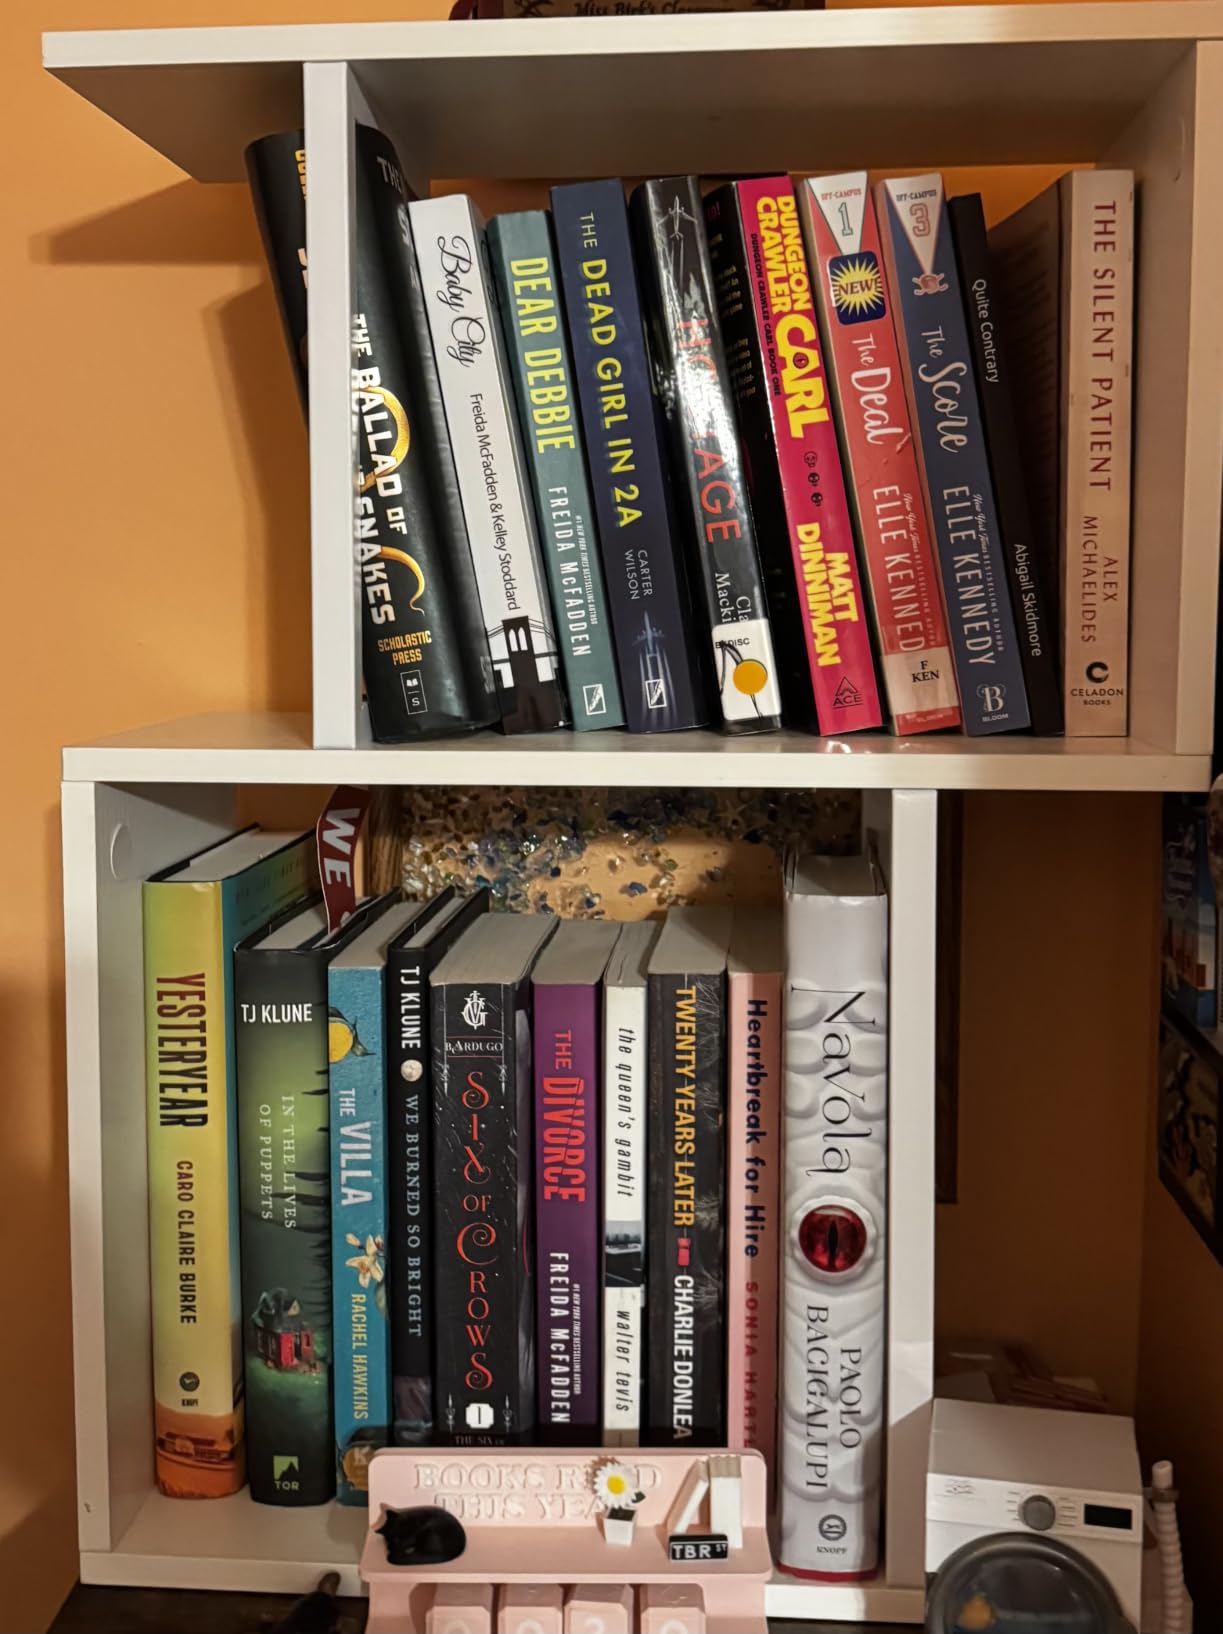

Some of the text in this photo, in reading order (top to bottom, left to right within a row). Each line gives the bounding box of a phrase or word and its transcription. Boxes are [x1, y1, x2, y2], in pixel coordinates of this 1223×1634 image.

[756, 196, 792, 315] CRAWLER
[776, 195, 812, 312] DUNGEON
[837, 202, 853, 236] 1
[909, 203, 931, 237] 3
[437, 235, 486, 368] Baby City
[510, 256, 576, 454] DEAR DEBBIE
[751, 233, 781, 396] DUNGEON CRAWLER CARL BOOK ONE
[972, 279, 999, 383] Quite Contrary
[1089, 200, 1116, 491] THE SILENT PATIENT
[579, 211, 643, 527] THE DEAD GIRL IN 2A
[775, 314, 830, 438] CARL
[851, 332, 903, 446] The Deal
[918, 325, 968, 453] The Score
[357, 366, 404, 497] BALLAD
[386, 506, 408, 535] OF
[676, 319, 742, 543] HOAGE
[470, 392, 521, 611] Freida McFadden & Kelley Stoddard
[548, 486, 576, 552] FREIDA
[624, 549, 640, 600] WILSON
[637, 549, 653, 596] CARTER
[796, 522, 842, 667] DINNIMAN
[825, 552, 859, 622] MATT
[873, 485, 925, 651] ELLE KENNED
[943, 485, 996, 665] ELLE KENNEDY
[1014, 543, 1042, 657] Abigail Skidmore
[1081, 515, 1098, 643] MICHAELIDES
[1103, 556, 1119, 602] ALEX
[377, 630, 432, 652] SCHOLASTIC
[392, 647, 422, 665] PRESS
[911, 670, 939, 683] KEN
[920, 660, 928, 670] F
[1070, 688, 1124, 697] CELADON
[833, 693, 862, 707] ACE
[155, 972, 208, 1127] YESTERYEAR
[241, 1003, 313, 1024] TJ KLUNE
[400, 965, 421, 1049] TJ KLUNE
[445, 1040, 503, 1053] BARDUGO
[461, 1071, 491, 1185] SIX
[543, 1030, 586, 1202] THE DIVORCE
[614, 1027, 636, 1197] the queen's gambit
[673, 985, 696, 1227] TWENTY YEARS LATER
[744, 999, 768, 1258] Heartbreak for Hire
[790, 983, 876, 1177] Navola
[259, 1104, 273, 1220] OF PUPPETS
[281, 1095, 296, 1229] IN THE LIVES
[339, 1087, 373, 1206] THE VILLA
[176, 1160, 197, 1324] CARO CLAIRE BURKE
[404, 1094, 422, 1337] WE BURNED SO BRIGHT
[457, 1222, 497, 1390] CROWS
[549, 1252, 569, 1317] FREIDA
[745, 1281, 759, 1357] SONIA
[350, 1294, 369, 1420] RACHEL HAWKINS
[615, 1310, 635, 1412] walter tevis
[672, 1274, 694, 1440] CHARLIE DONLEA
[805, 1304, 829, 1488] BACIGALUPI
[839, 1348, 862, 1449] PAOLO
[274, 1481, 299, 1490] TOR
[414, 1463, 663, 1489] BOOKS RD
[434, 1493, 528, 1519] THIS
[672, 1544, 711, 1558] TBR
